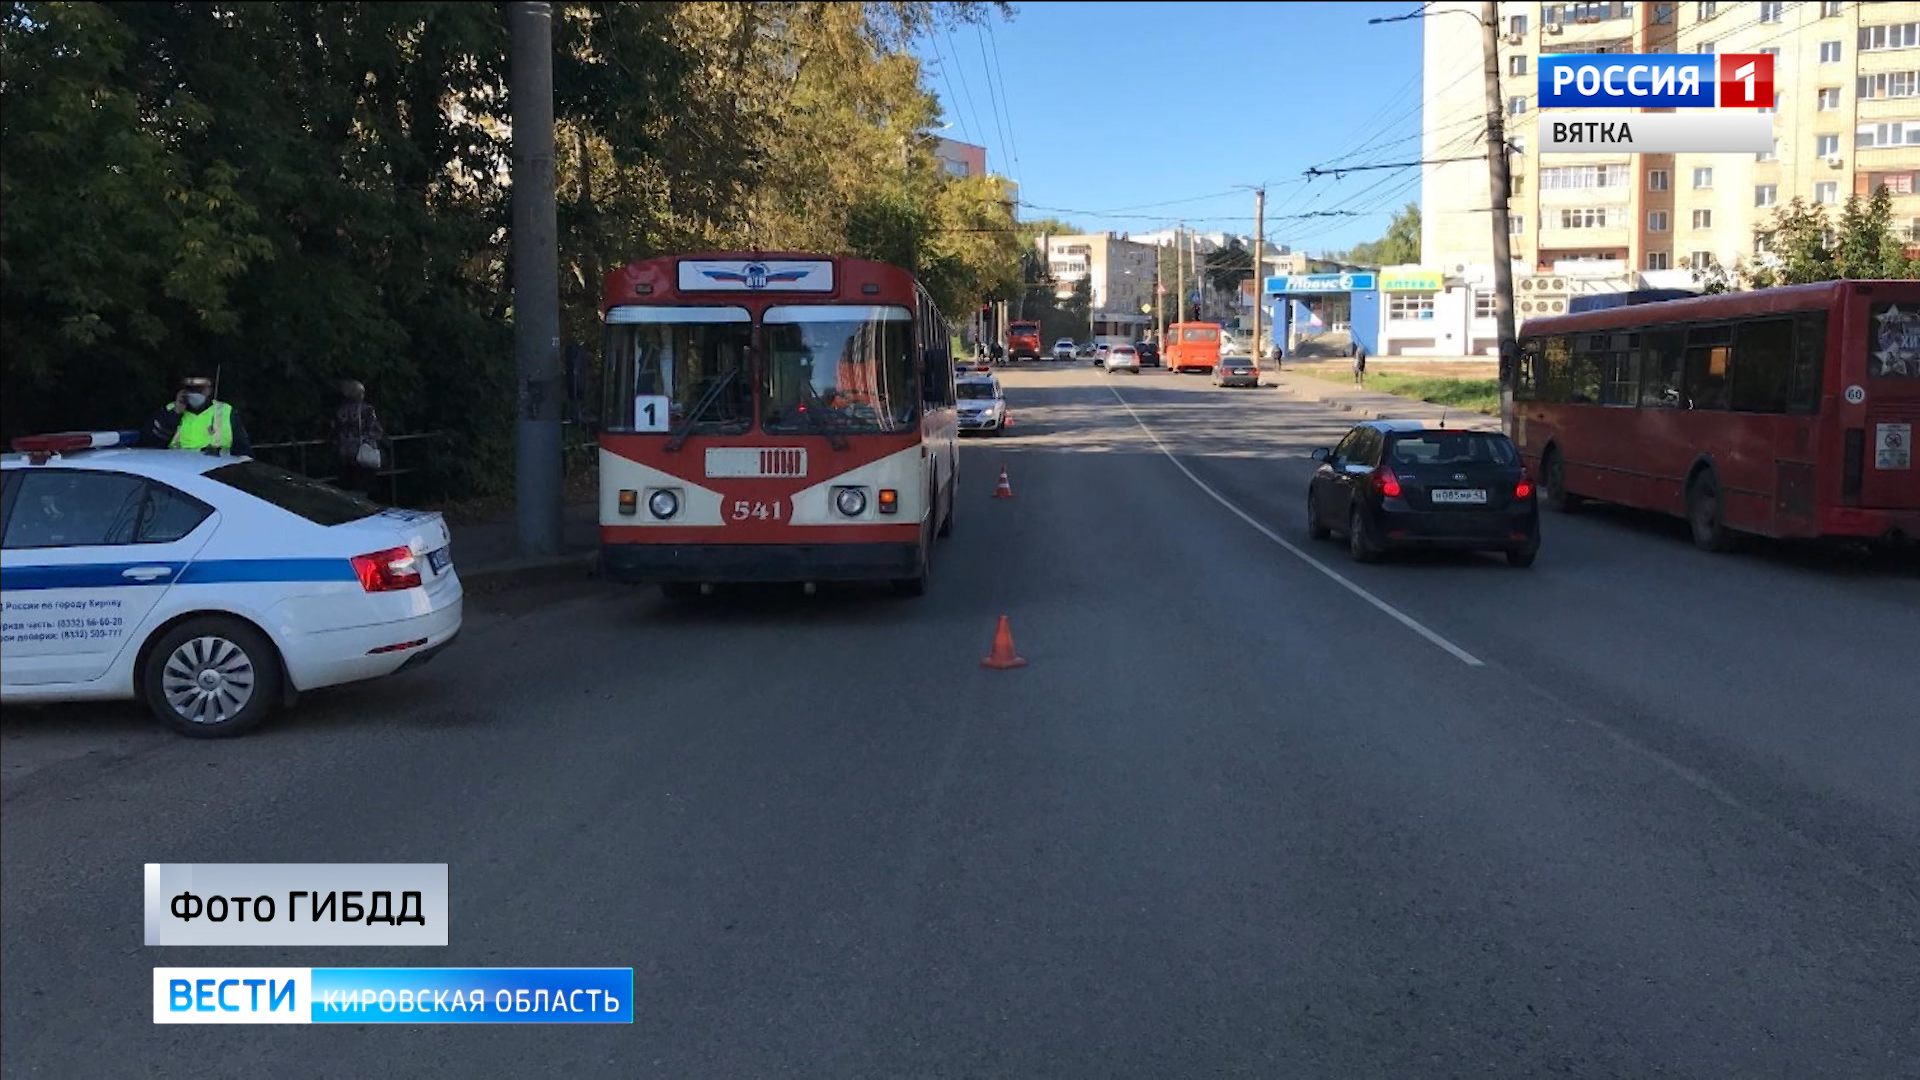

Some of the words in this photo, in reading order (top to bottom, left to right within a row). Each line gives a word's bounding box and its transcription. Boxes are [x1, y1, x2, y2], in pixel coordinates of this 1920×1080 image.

[1386, 279, 1437, 288] АПТЕКА
[1848, 389, 1862, 400] 60
[643, 403, 655, 426] 1
[732, 501, 781, 520] 541
[5, 602, 39, 610] России
[55, 601, 86, 610] городу
